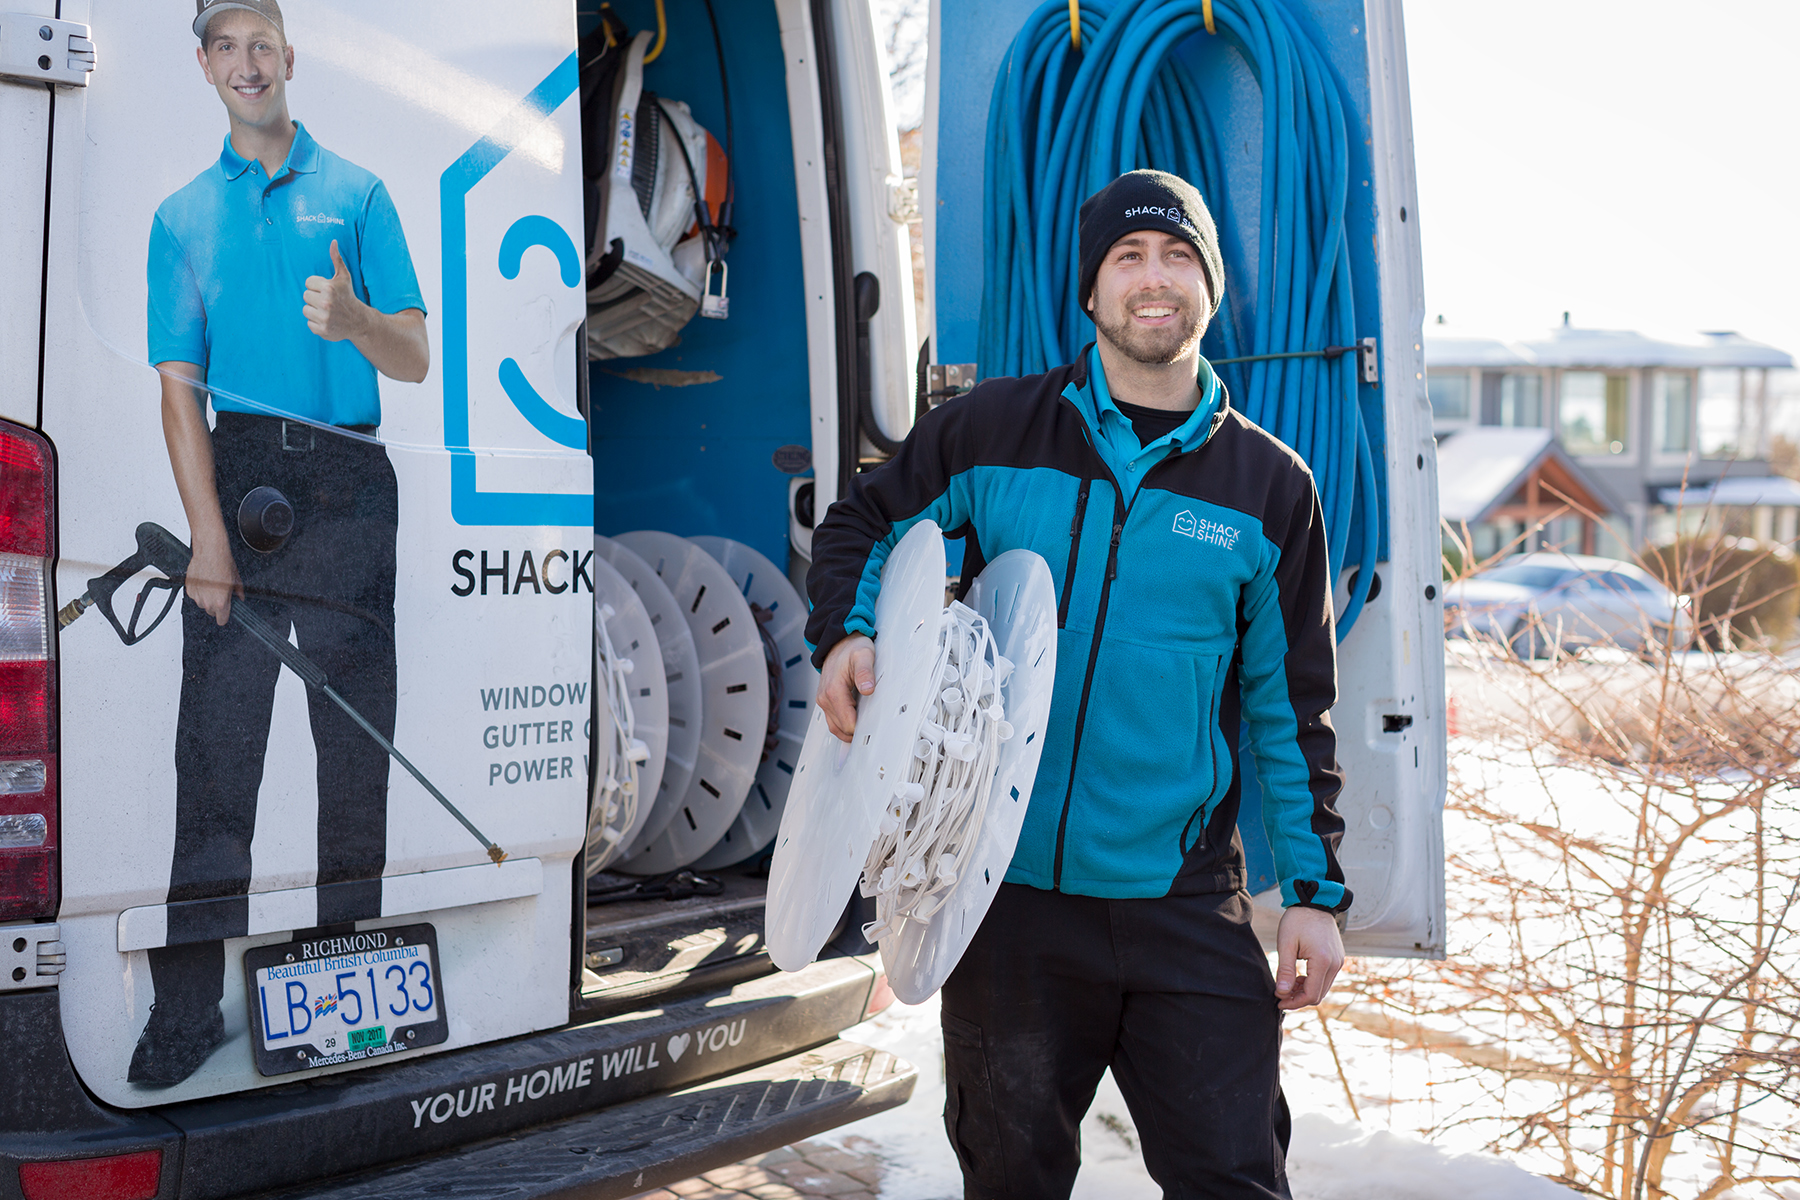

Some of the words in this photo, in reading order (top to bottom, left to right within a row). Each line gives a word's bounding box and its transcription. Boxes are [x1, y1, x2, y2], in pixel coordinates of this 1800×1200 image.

[296, 215, 317, 223] SHACK
[326, 216, 345, 226] SHINE
[1125, 205, 1166, 218] SHACK
[1196, 529, 1235, 551] SHINE
[1199, 518, 1241, 541] SHACK
[450, 549, 594, 597] SHACK
[480, 682, 587, 712] WINDOW
[483, 719, 573, 749] GUTTER
[489, 756, 573, 786] POWER
[302, 932, 388, 959] RICHMOND
[267, 957, 321, 981] Beautiful
[324, 953, 362, 972] British
[363, 946, 419, 966] Columbia
[335, 960, 434, 1025] 5133
[324, 1037, 337, 1049] 29
[351, 1030, 364, 1045] NOV
[367, 1027, 383, 1041] 2017
[308, 1048, 367, 1068] Mercedes-Benz
[366, 1042, 393, 1058] Canada
[393, 1040, 408, 1053] Inc.
[410, 1083, 497, 1128] YOUR
[504, 1057, 595, 1106] HOME
[601, 1042, 660, 1081] WILL
[696, 1018, 747, 1055] YOU
